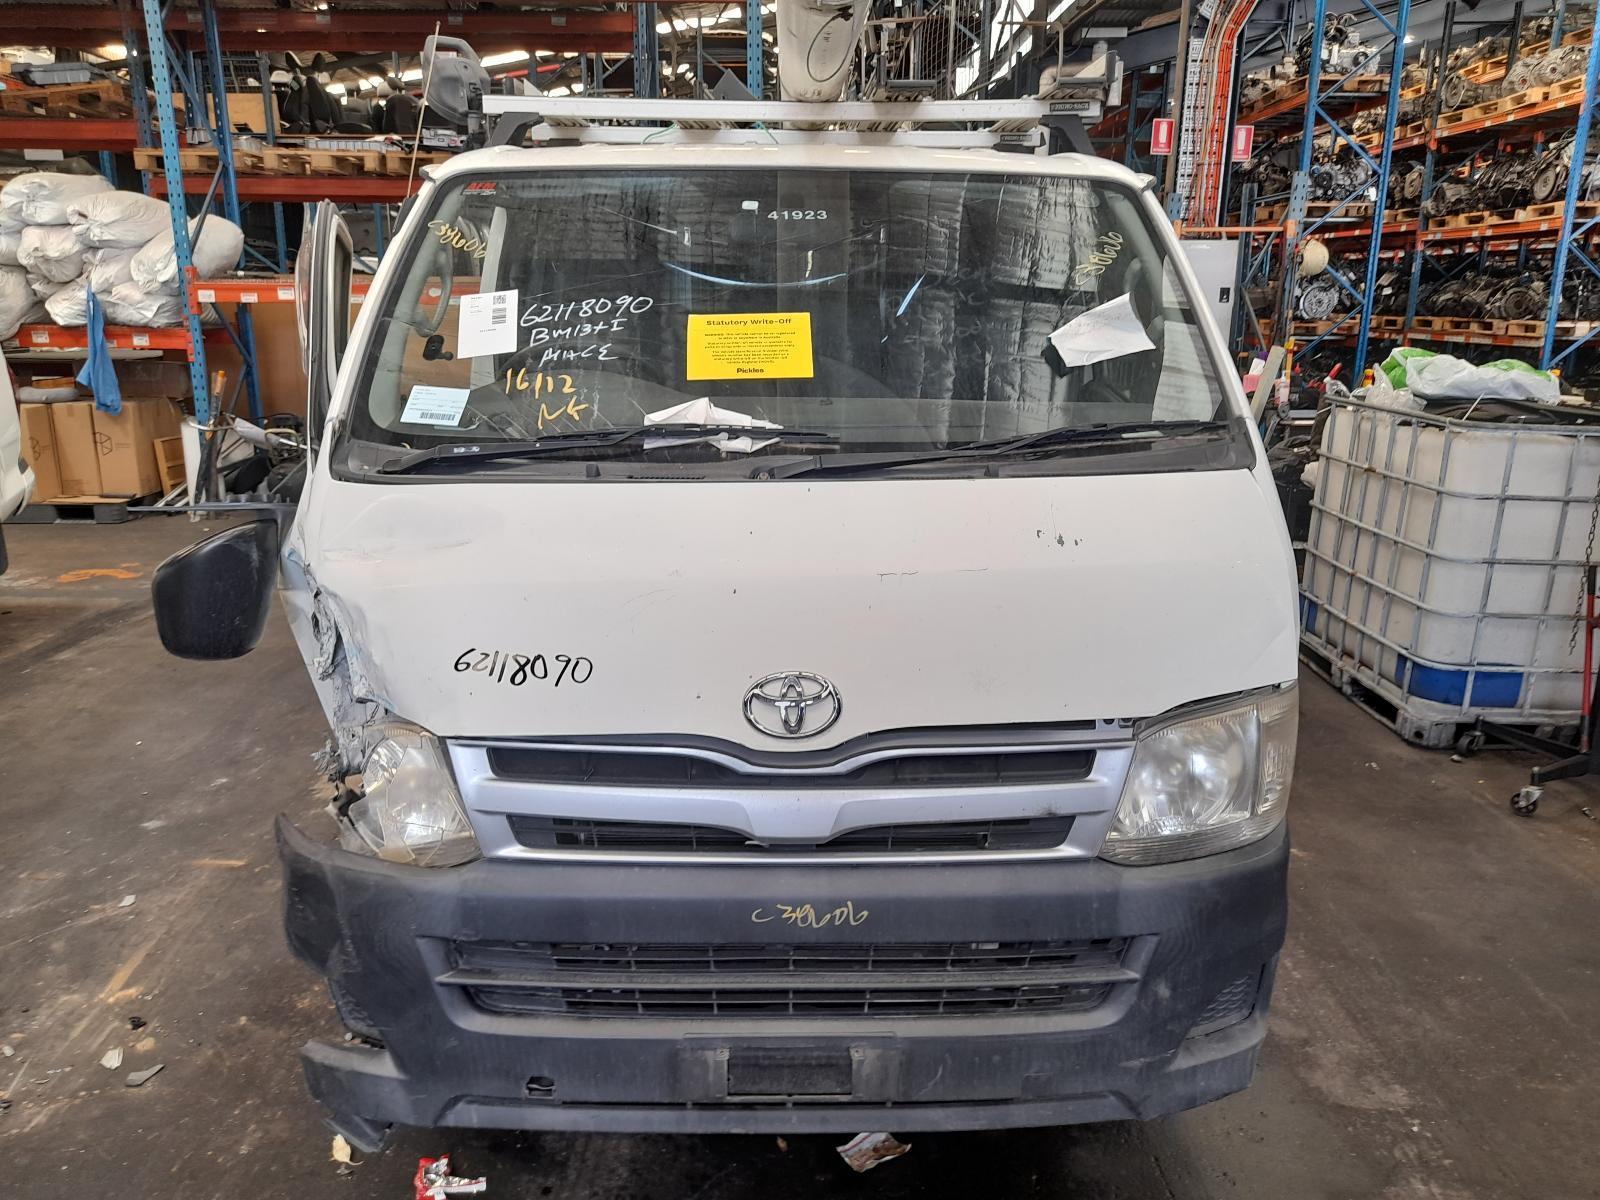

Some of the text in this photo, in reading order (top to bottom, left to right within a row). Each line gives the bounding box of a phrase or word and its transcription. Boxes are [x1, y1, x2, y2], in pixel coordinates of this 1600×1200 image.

[767, 210, 828, 220] 41923
[520, 295, 653, 327] 62118090
[706, 319, 748, 327] Statutory
[505, 367, 577, 400] 16/12
[454, 648, 593, 687] 62118090
